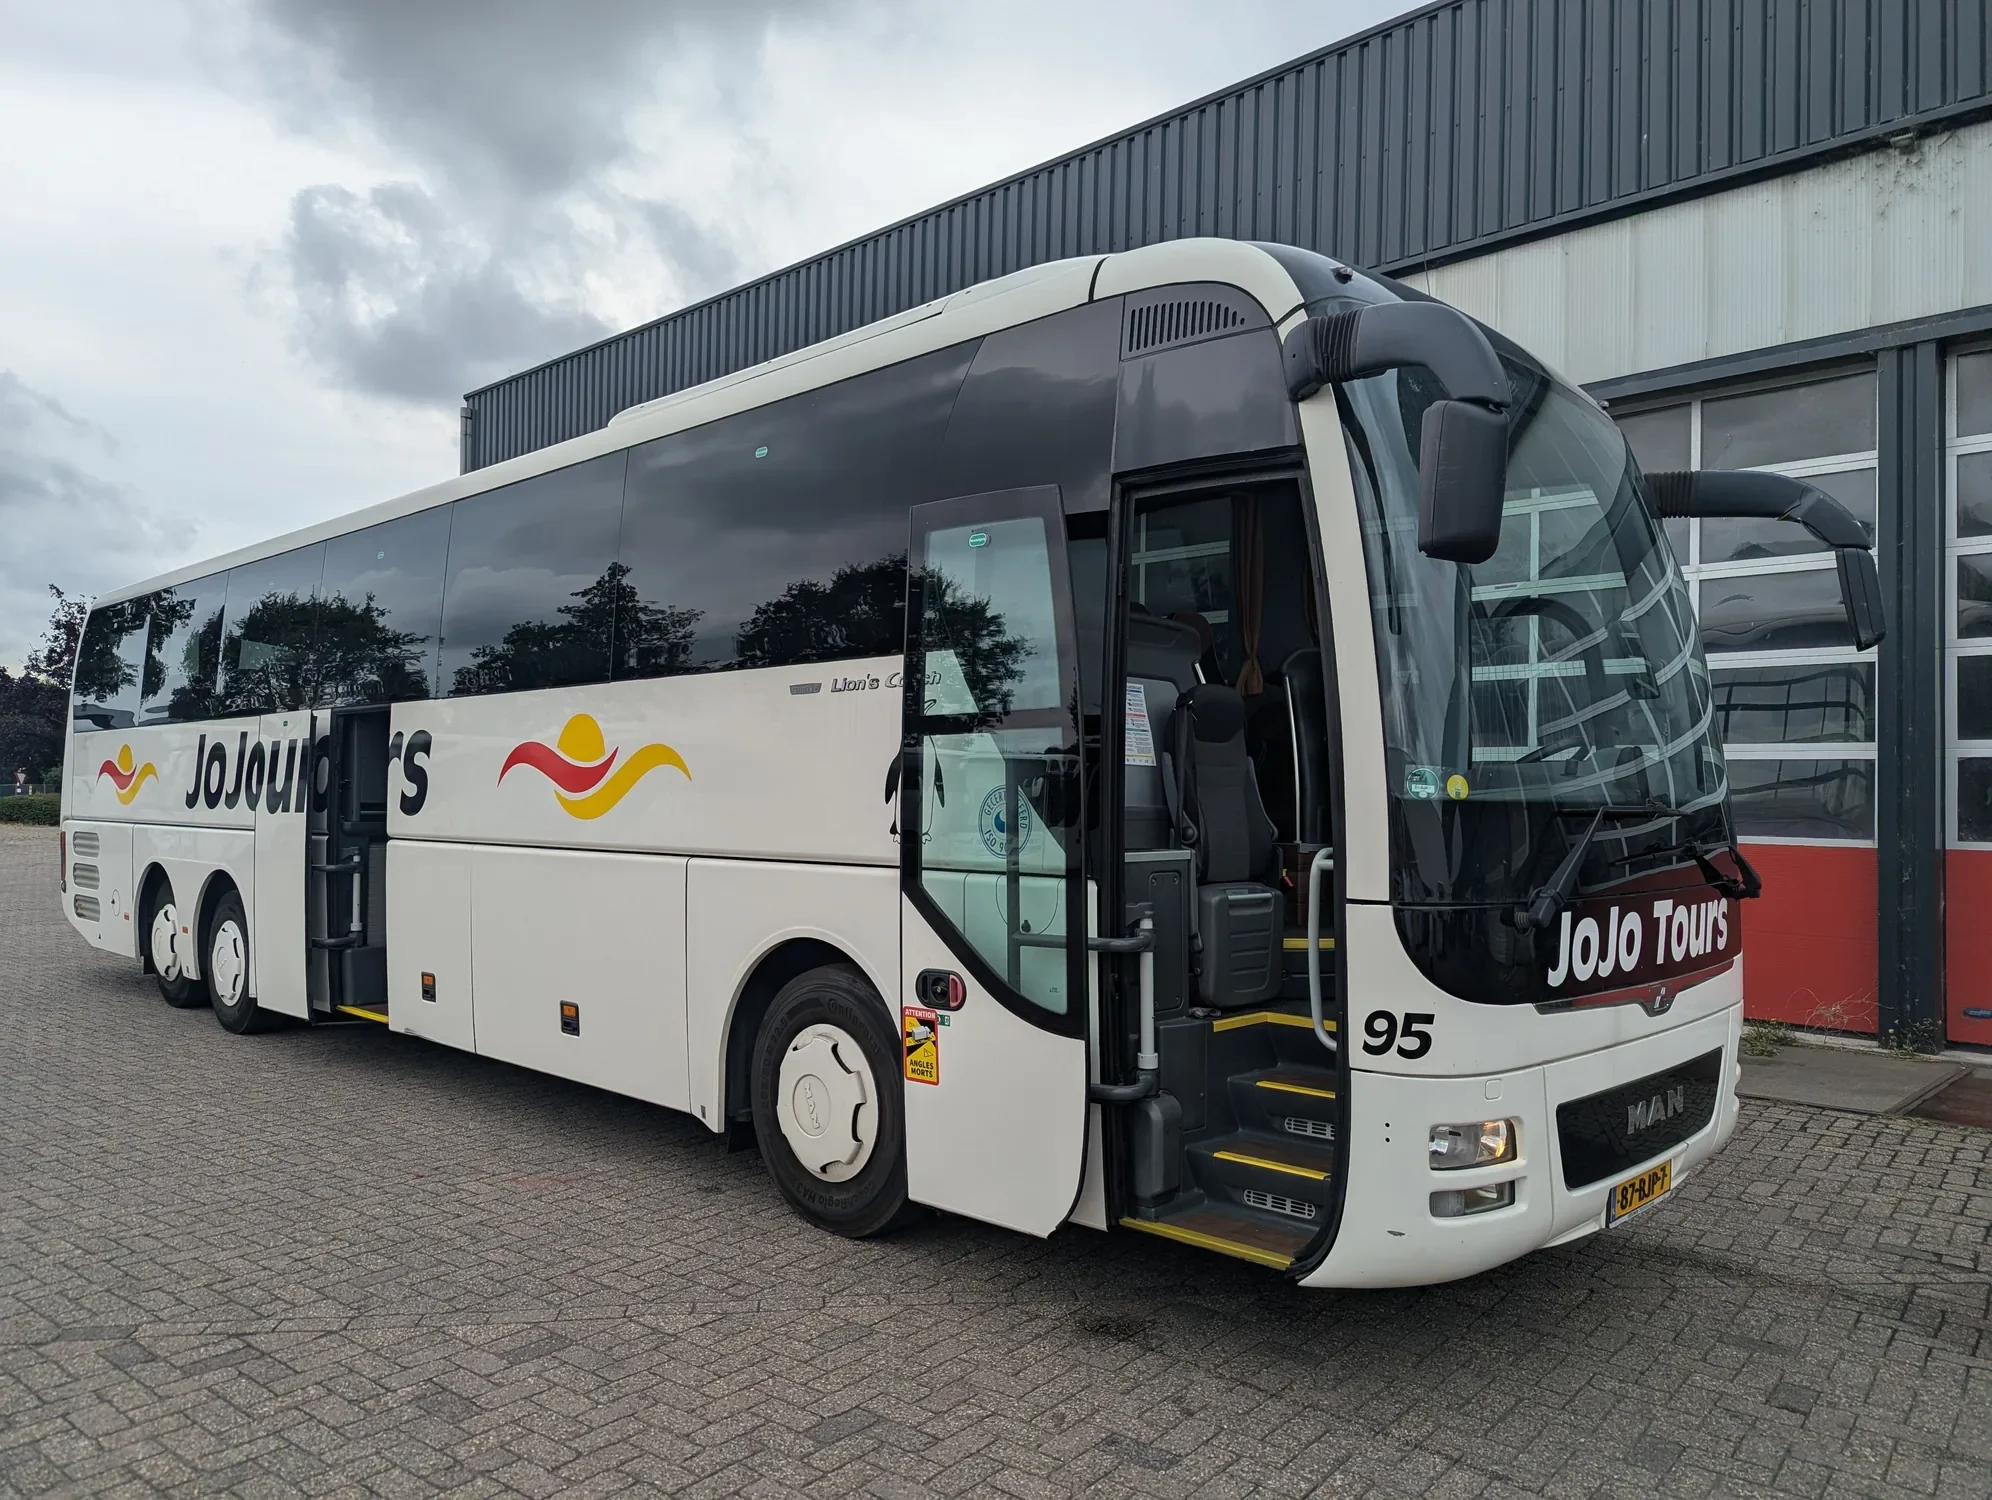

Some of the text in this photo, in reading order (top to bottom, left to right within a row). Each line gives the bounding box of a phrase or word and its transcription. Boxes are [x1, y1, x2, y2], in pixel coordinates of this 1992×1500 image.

[830, 673, 880, 693] Lion's
[984, 829, 997, 847] ISO
[1547, 897, 1728, 988] JoJo Tours
[905, 1008, 936, 1019] ATTENTION
[1362, 1009, 1435, 1060] 95
[909, 1059, 934, 1070] ANGLES
[910, 1067, 933, 1078] MORTS
[804, 1082, 820, 1130] MAN
[1627, 1085, 1684, 1134] MAN
[1619, 1165, 1668, 1211] 87-BJP-7
